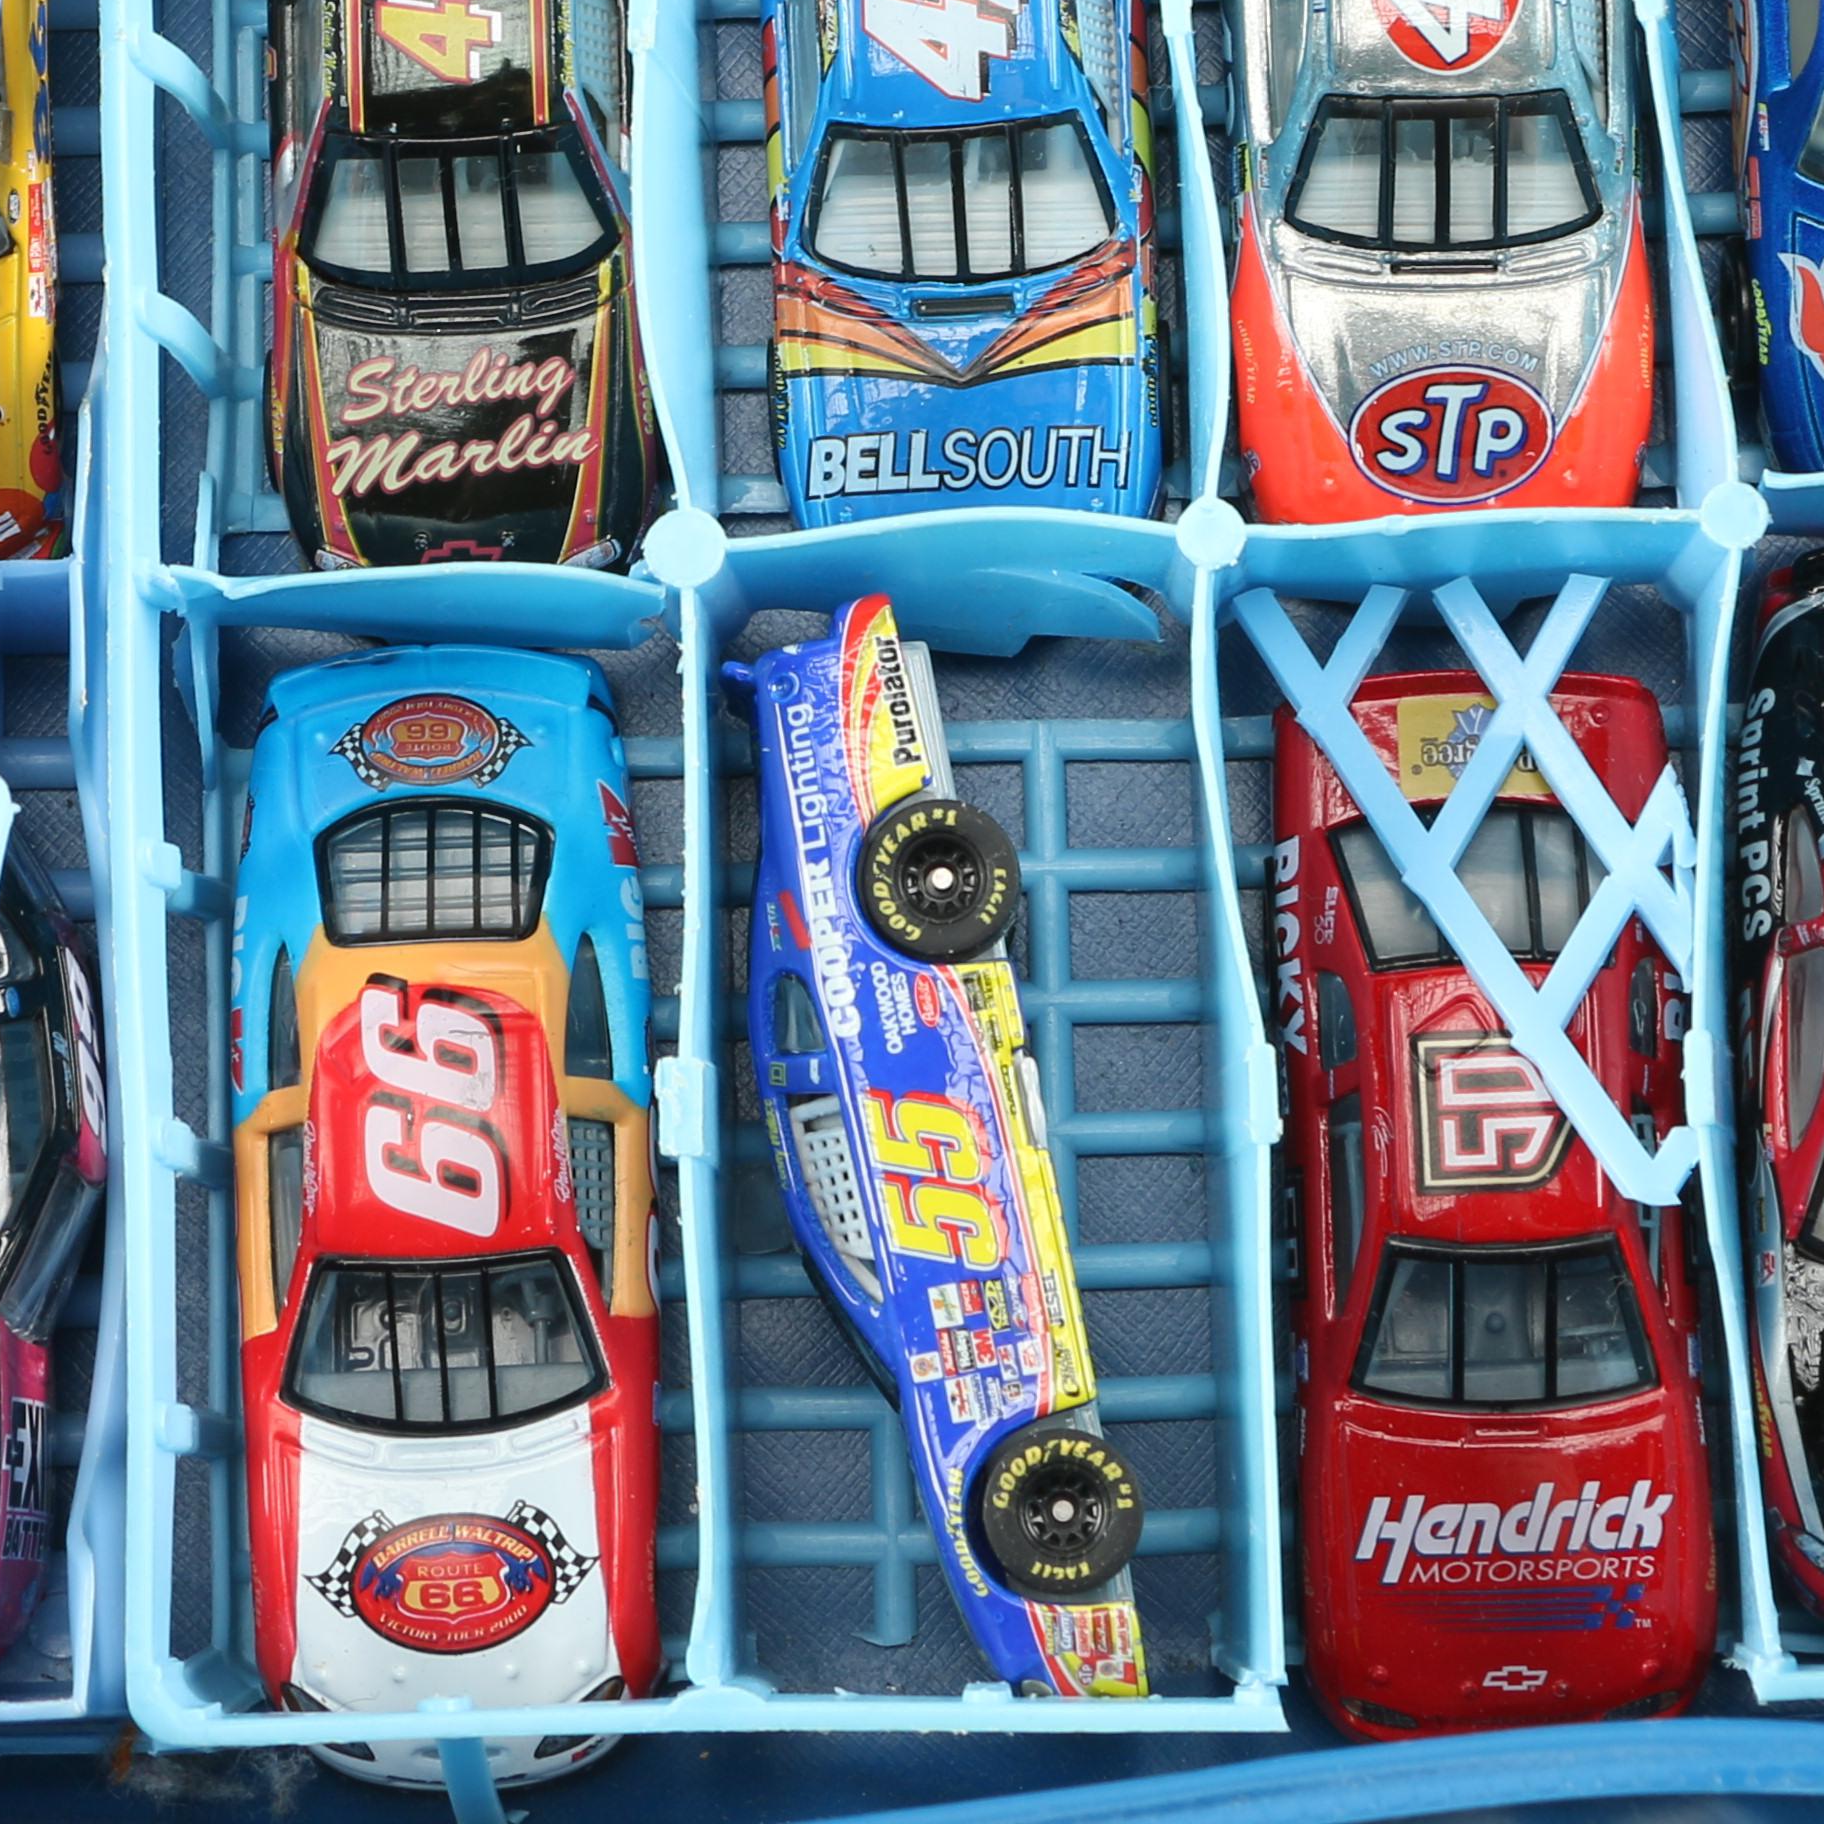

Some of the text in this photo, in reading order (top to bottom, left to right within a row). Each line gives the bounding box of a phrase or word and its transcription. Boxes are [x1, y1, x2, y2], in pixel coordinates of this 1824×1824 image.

[1371, 339, 1540, 378] WWW.STP.COM
[1752, 278, 1771, 366] GOODYEAR
[343, 346, 573, 423] Sterling
[1237, 320, 1257, 404] GOODYEAR
[326, 417, 599, 496] Marlin
[806, 427, 1131, 500] BELLSOUTH
[1376, 382, 1526, 482] STP
[407, 724, 449, 739] 66
[876, 636, 920, 768] Purolator
[1740, 686, 1774, 942] Sprint PCS
[786, 703, 860, 1038] COOPER Lighting
[874, 813, 930, 942] GOODYEAR
[981, 868, 1006, 925] EAGLE
[1275, 836, 1307, 1056] RICKY
[876, 962, 902, 1055] OAKWOOD
[891, 972, 917, 1035] HOMES
[360, 985, 502, 1237] 66
[864, 1087, 1002, 1271] 55
[1043, 1269, 1064, 1327] JESEL
[974, 1330, 995, 1364] 3M
[993, 1439, 1122, 1508] GOODYEAR
[373, 1524, 534, 1569] DARRELL WALTRIP
[417, 1562, 482, 1577] ROUTE
[944, 1467, 991, 1596] GOODYEAR
[1356, 1480, 1673, 1584] Hendrick
[1408, 1556, 1656, 1583] MOTORSPORTS
[379, 1605, 528, 1641] VICTORY TOUR 2000
[420, 1581, 483, 1607] 66
